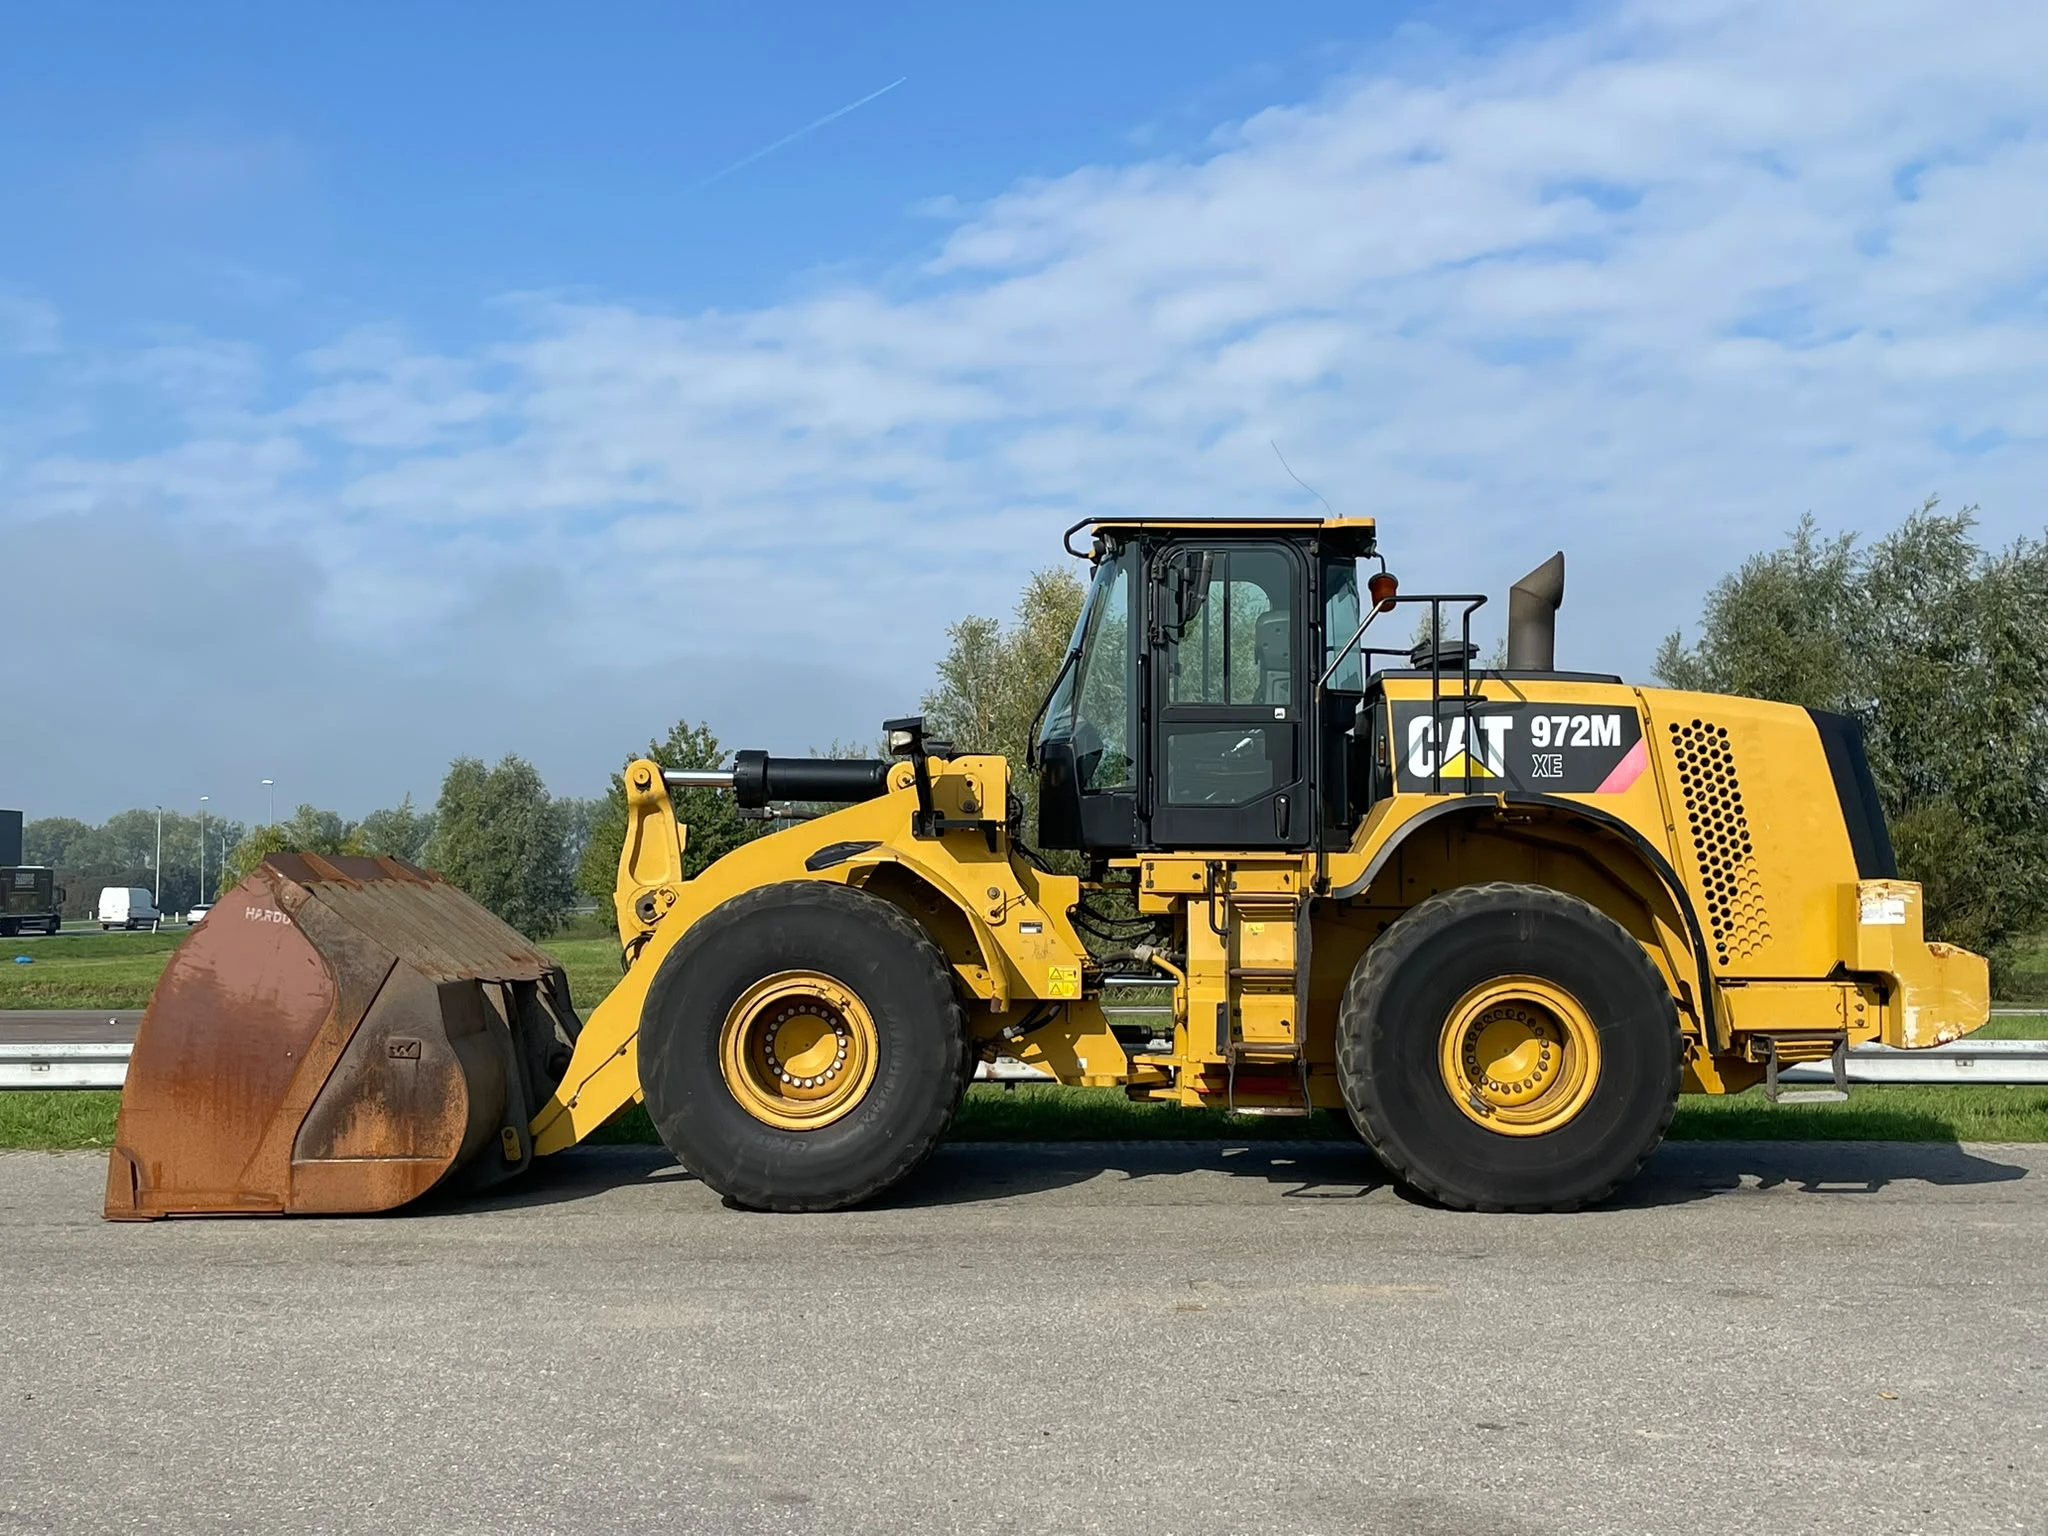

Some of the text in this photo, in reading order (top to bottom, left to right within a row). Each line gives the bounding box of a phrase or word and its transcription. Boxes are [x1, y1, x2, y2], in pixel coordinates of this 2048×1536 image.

[1531, 714, 1621, 748] 972M
[1408, 715, 1513, 778] CAT
[1531, 754, 1563, 778] XE
[245, 907, 293, 925] HARDO
